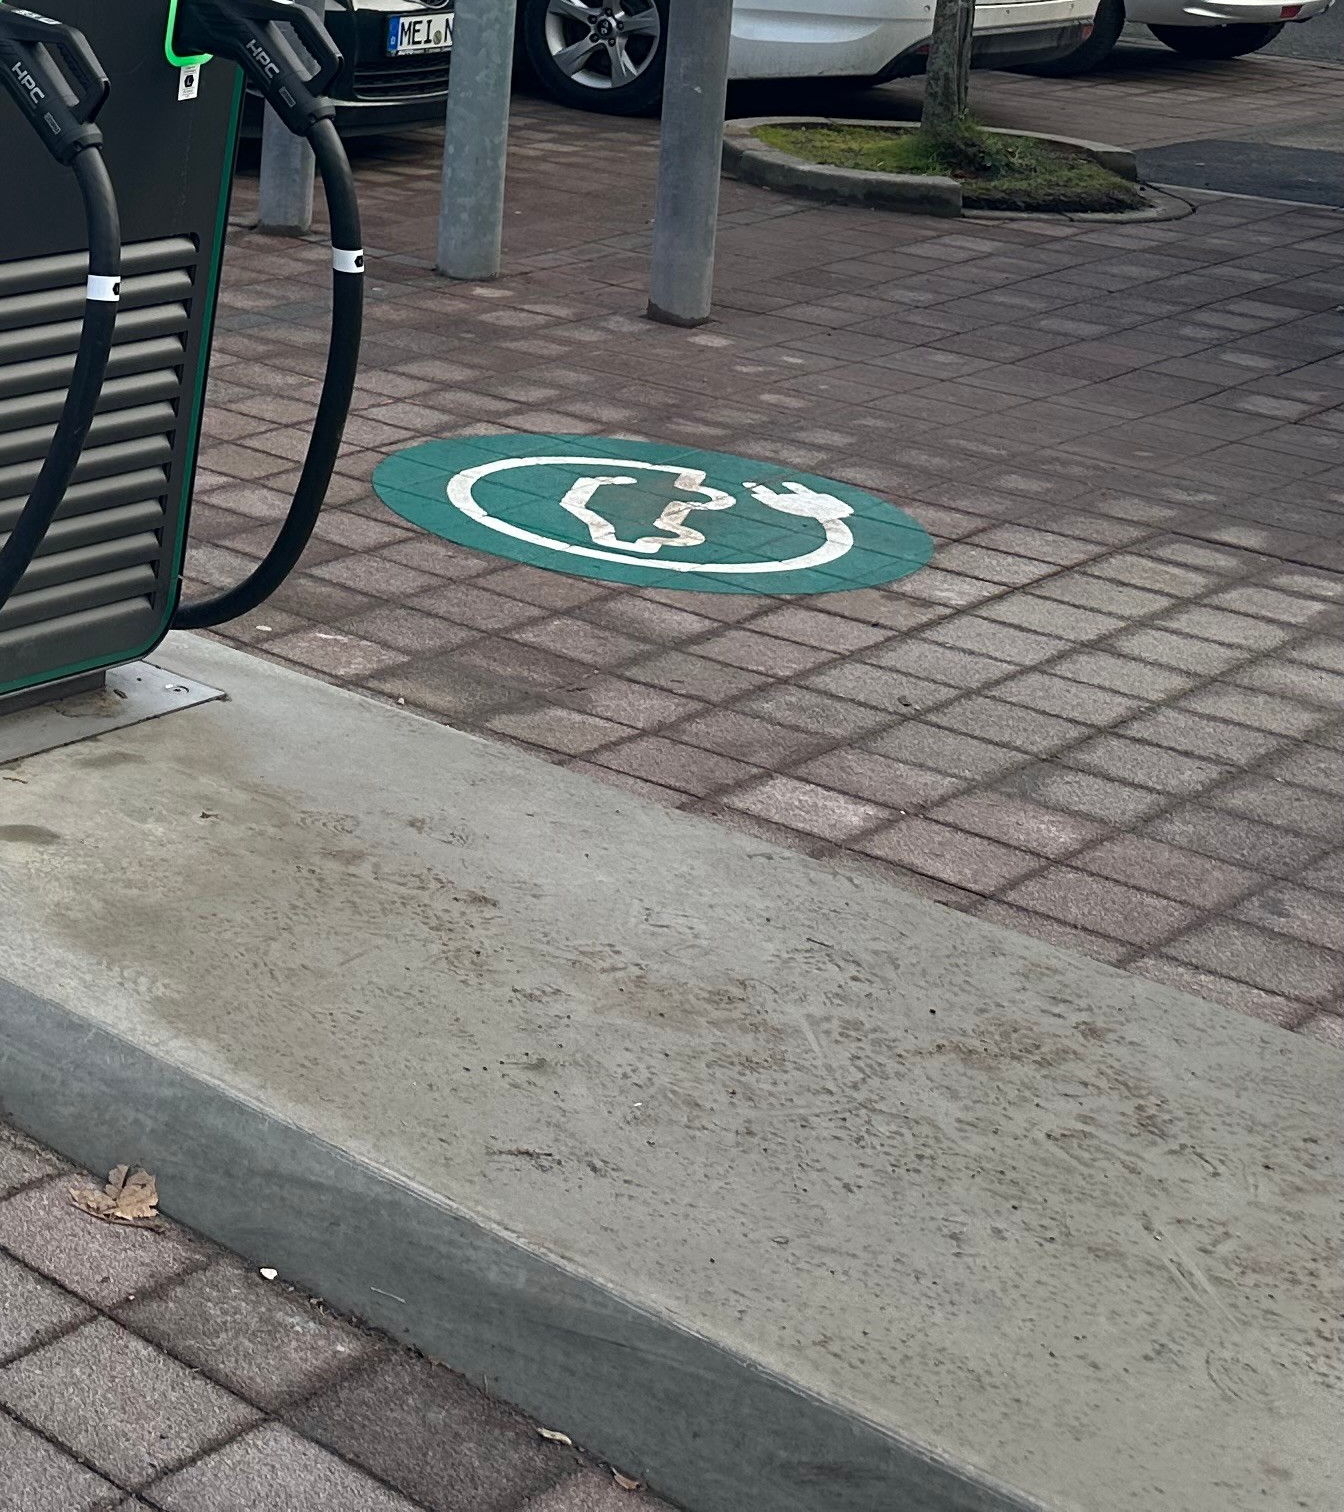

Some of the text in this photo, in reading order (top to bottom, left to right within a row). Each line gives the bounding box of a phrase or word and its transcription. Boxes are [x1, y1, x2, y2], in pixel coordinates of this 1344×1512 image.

[400, 19, 433, 46] MEI
[245, 38, 281, 79] HPC
[11, 61, 46, 104] HPC
